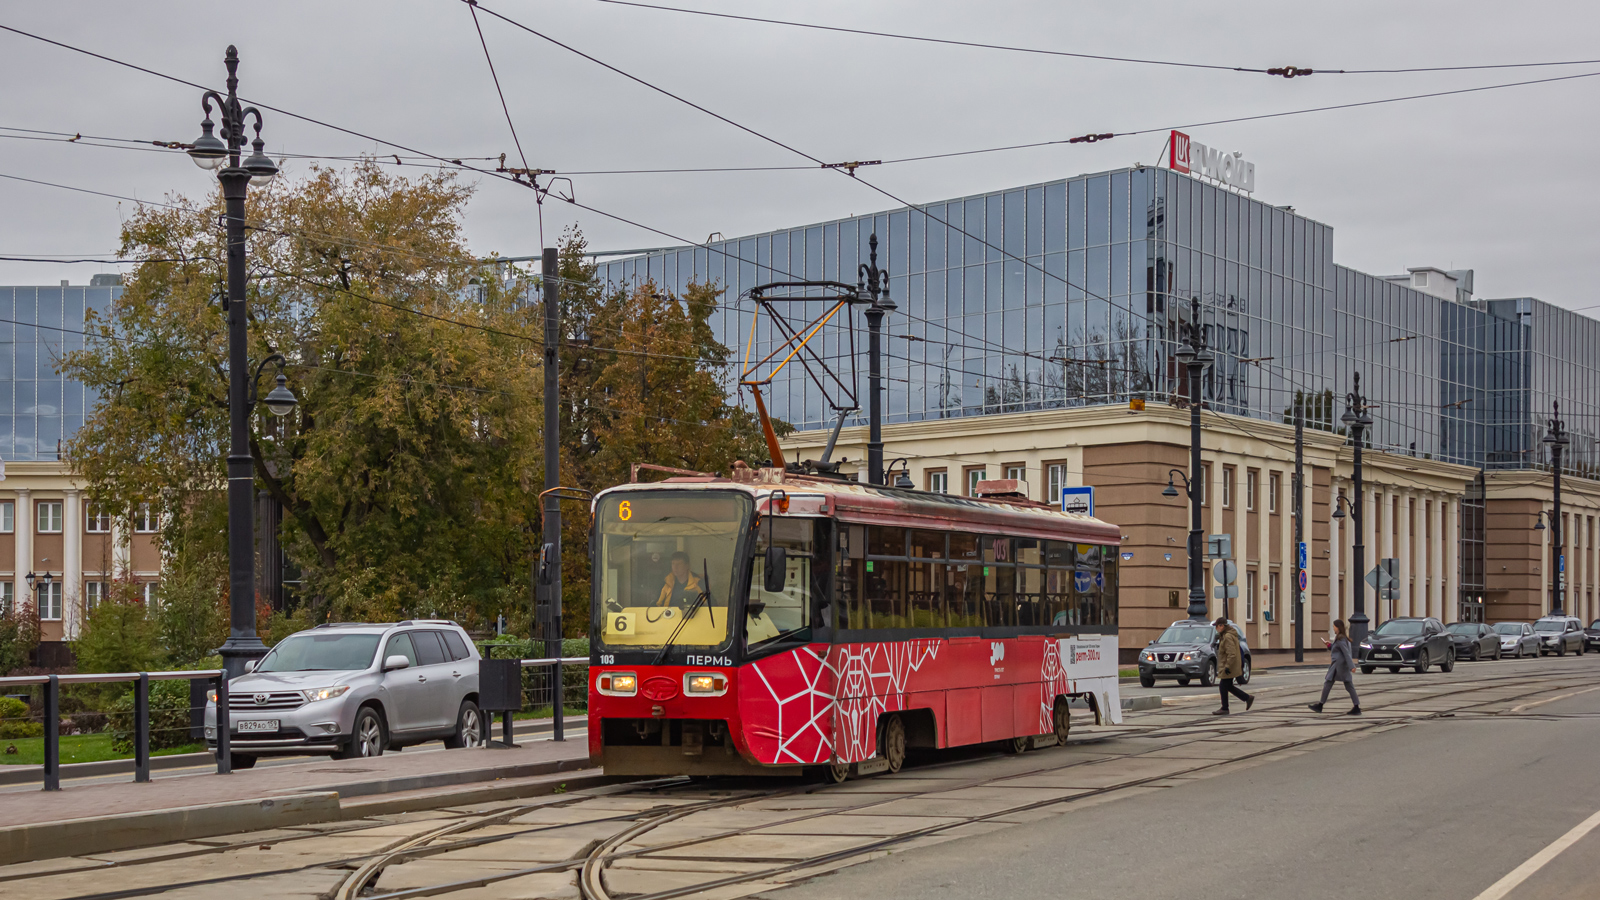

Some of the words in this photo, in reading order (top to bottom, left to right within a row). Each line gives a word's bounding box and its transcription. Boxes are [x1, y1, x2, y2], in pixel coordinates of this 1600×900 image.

[618, 500, 632, 521] 6
[992, 538, 1007, 560] 103
[614, 615, 628, 632] 6
[600, 654, 615, 665] 103
[686, 655, 733, 666] ПЕРМЬ
[1076, 649, 1101, 664] perm-300.ru
